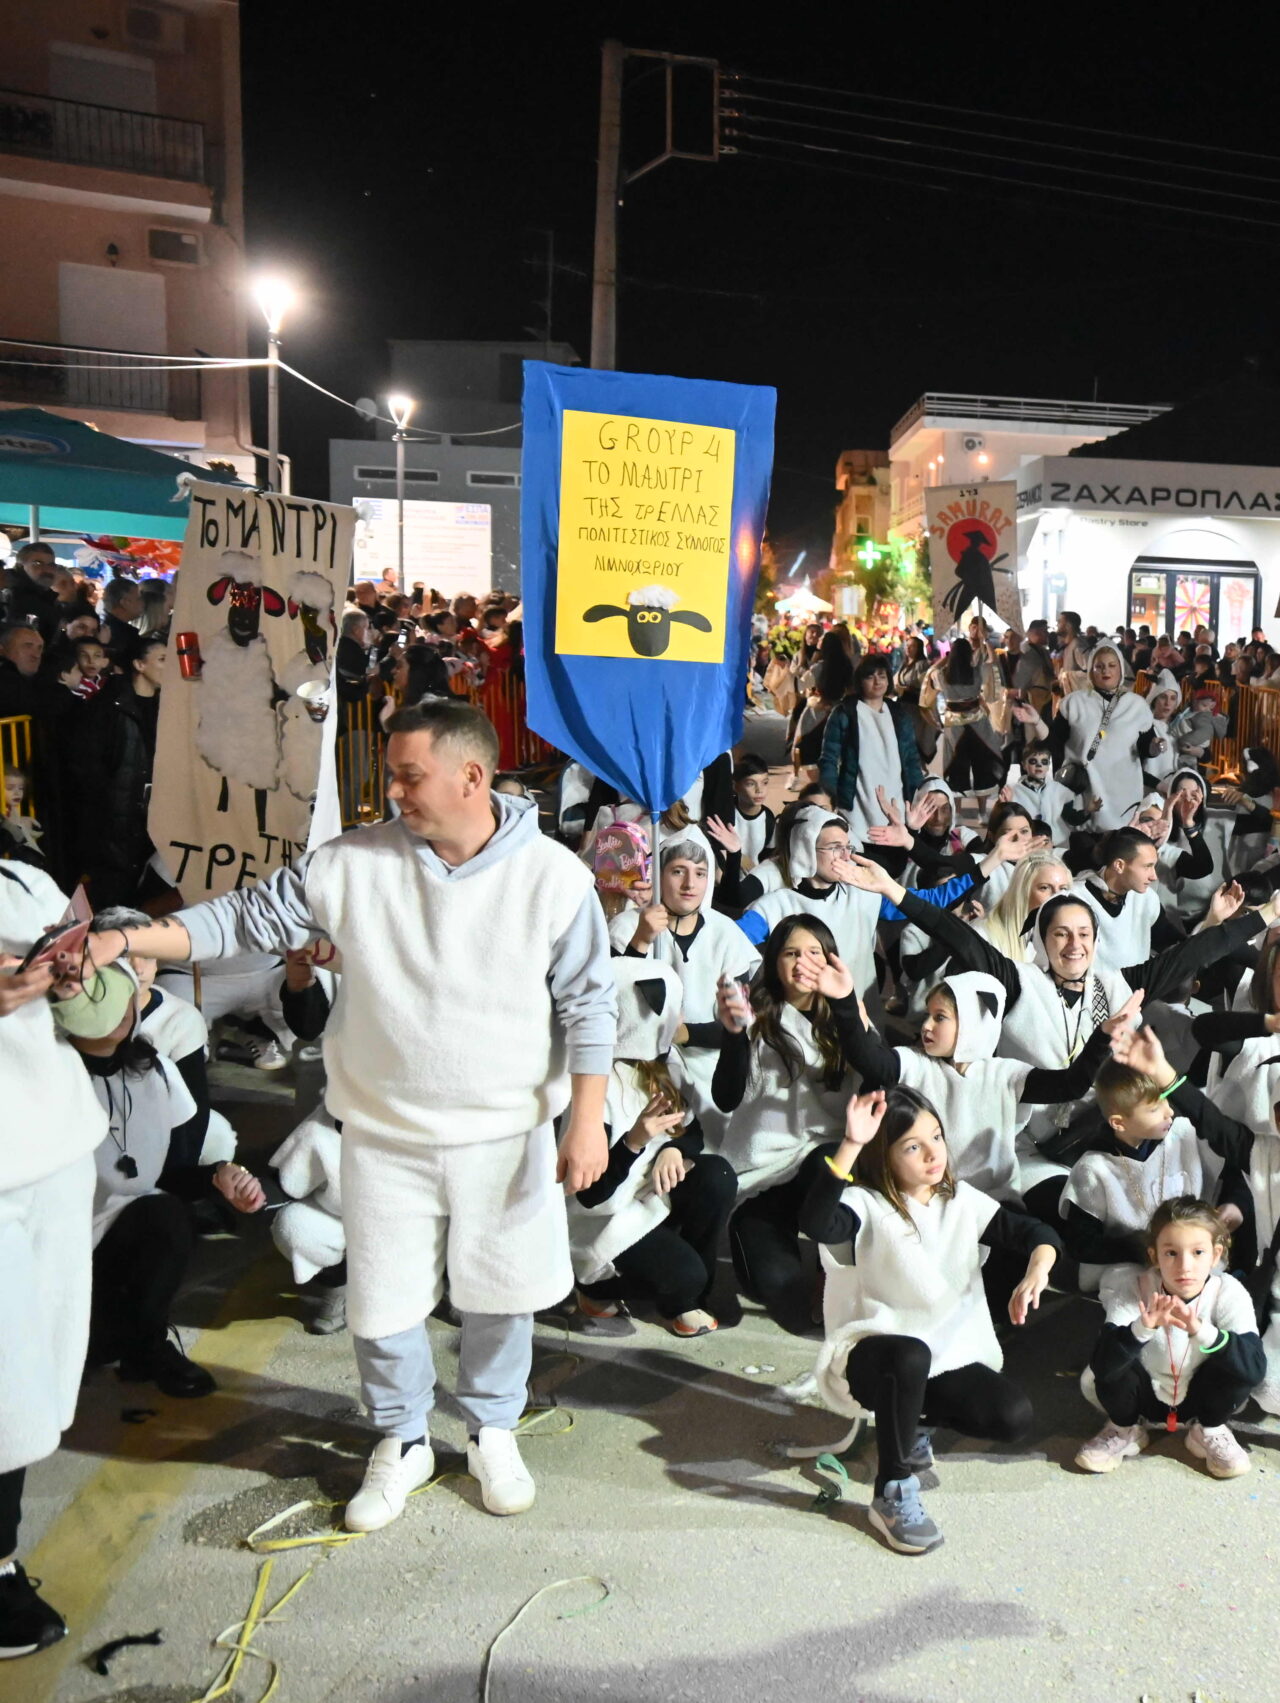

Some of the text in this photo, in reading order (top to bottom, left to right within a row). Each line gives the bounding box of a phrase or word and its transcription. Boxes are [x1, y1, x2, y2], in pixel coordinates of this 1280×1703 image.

[702, 434, 721, 463] 4
[582, 460, 703, 493] ΤΟ ΜΑΝΤΡΙ
[583, 496, 623, 519] ΤΗΣ
[929, 498, 1012, 540] SAMURAI
[226, 497, 337, 569] ΜΑΝΤΡΙ
[1118, 518, 1149, 527] Store
[578, 526, 726, 554] ΠΟΛΙΤΙΣΤΙΚΟΣ ΣΥΛΛΟΓΟΣ
[594, 554, 684, 577] ΛΙΜΝΟΧΩΡΙΟΥ
